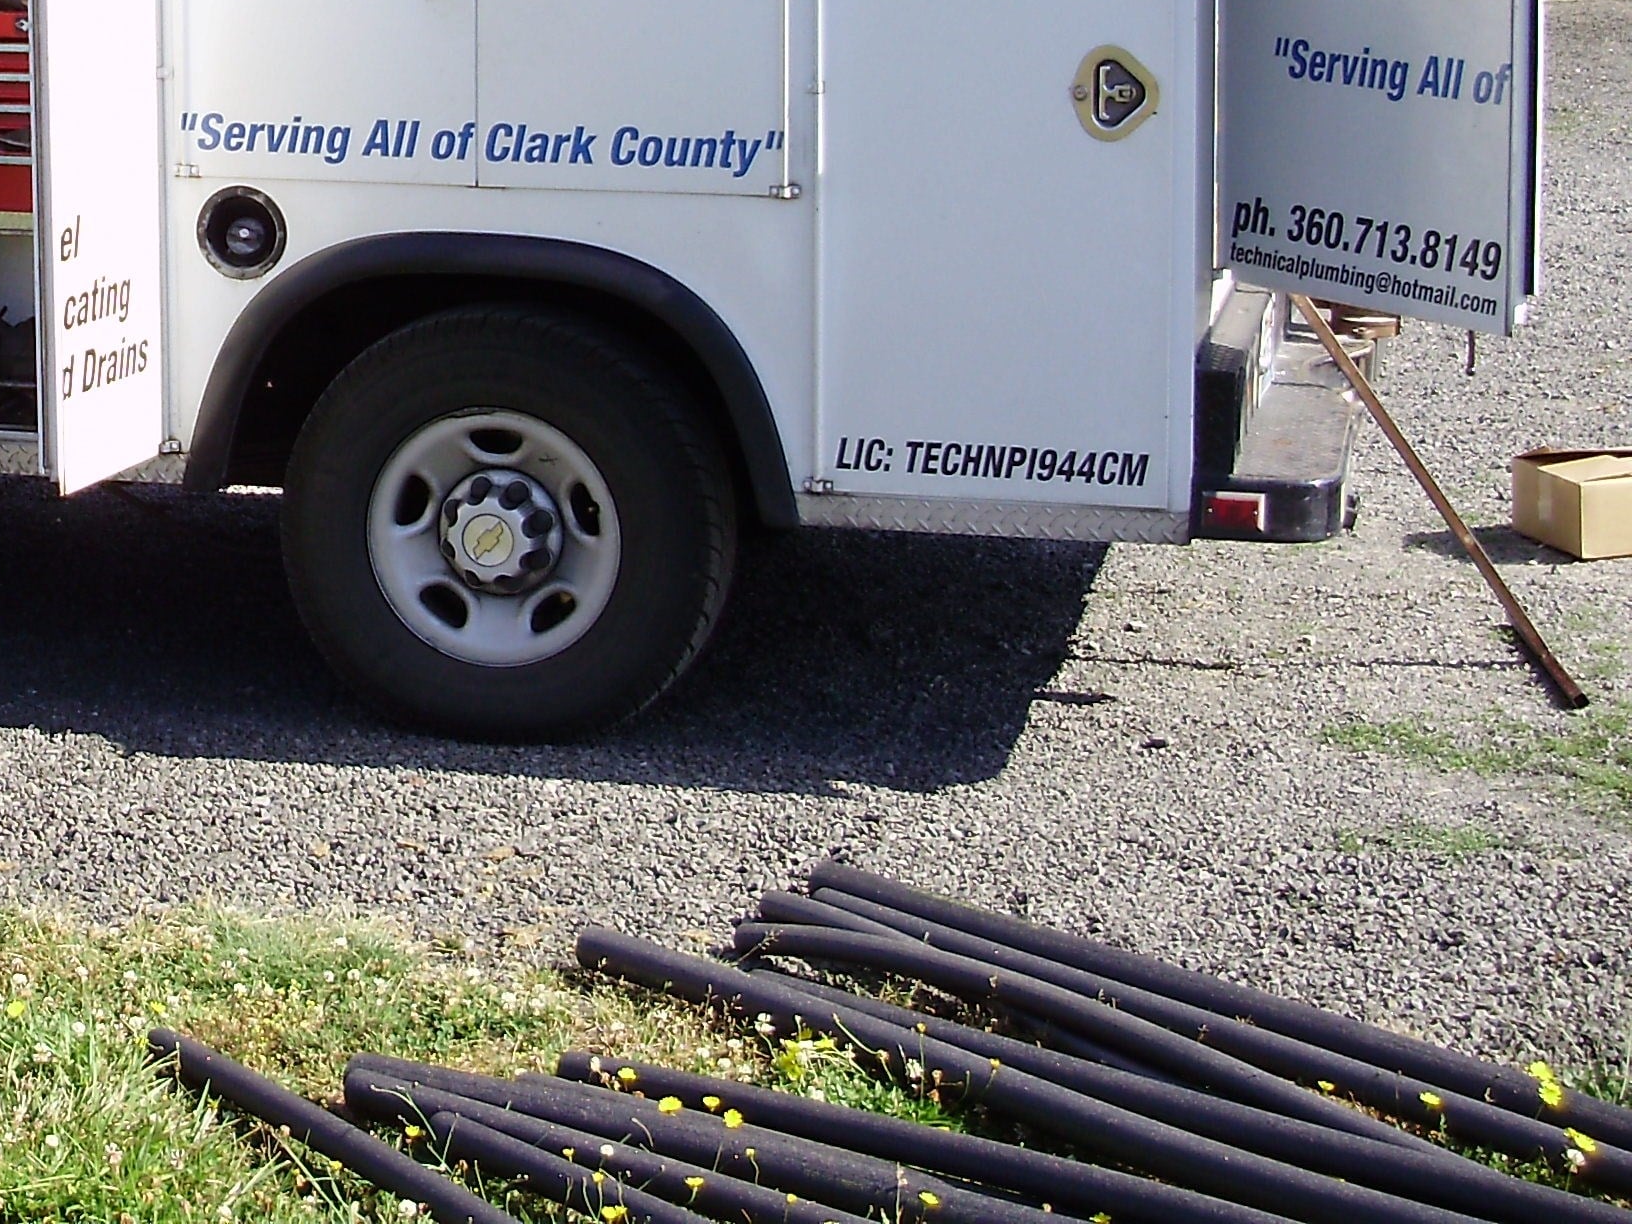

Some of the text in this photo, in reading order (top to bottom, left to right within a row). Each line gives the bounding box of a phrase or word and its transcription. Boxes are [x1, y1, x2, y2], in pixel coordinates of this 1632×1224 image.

[1274, 36, 1512, 105] "Serving All of
[181, 112, 785, 177] "Serving All of Clark County"
[1231, 197, 1502, 280] ph. 360.713.8149
[63, 276, 131, 330] cating
[1230, 242, 1497, 316] technicalplumbing@hotmail.com
[82, 337, 149, 393] Drains
[835, 437, 894, 472] LIC:
